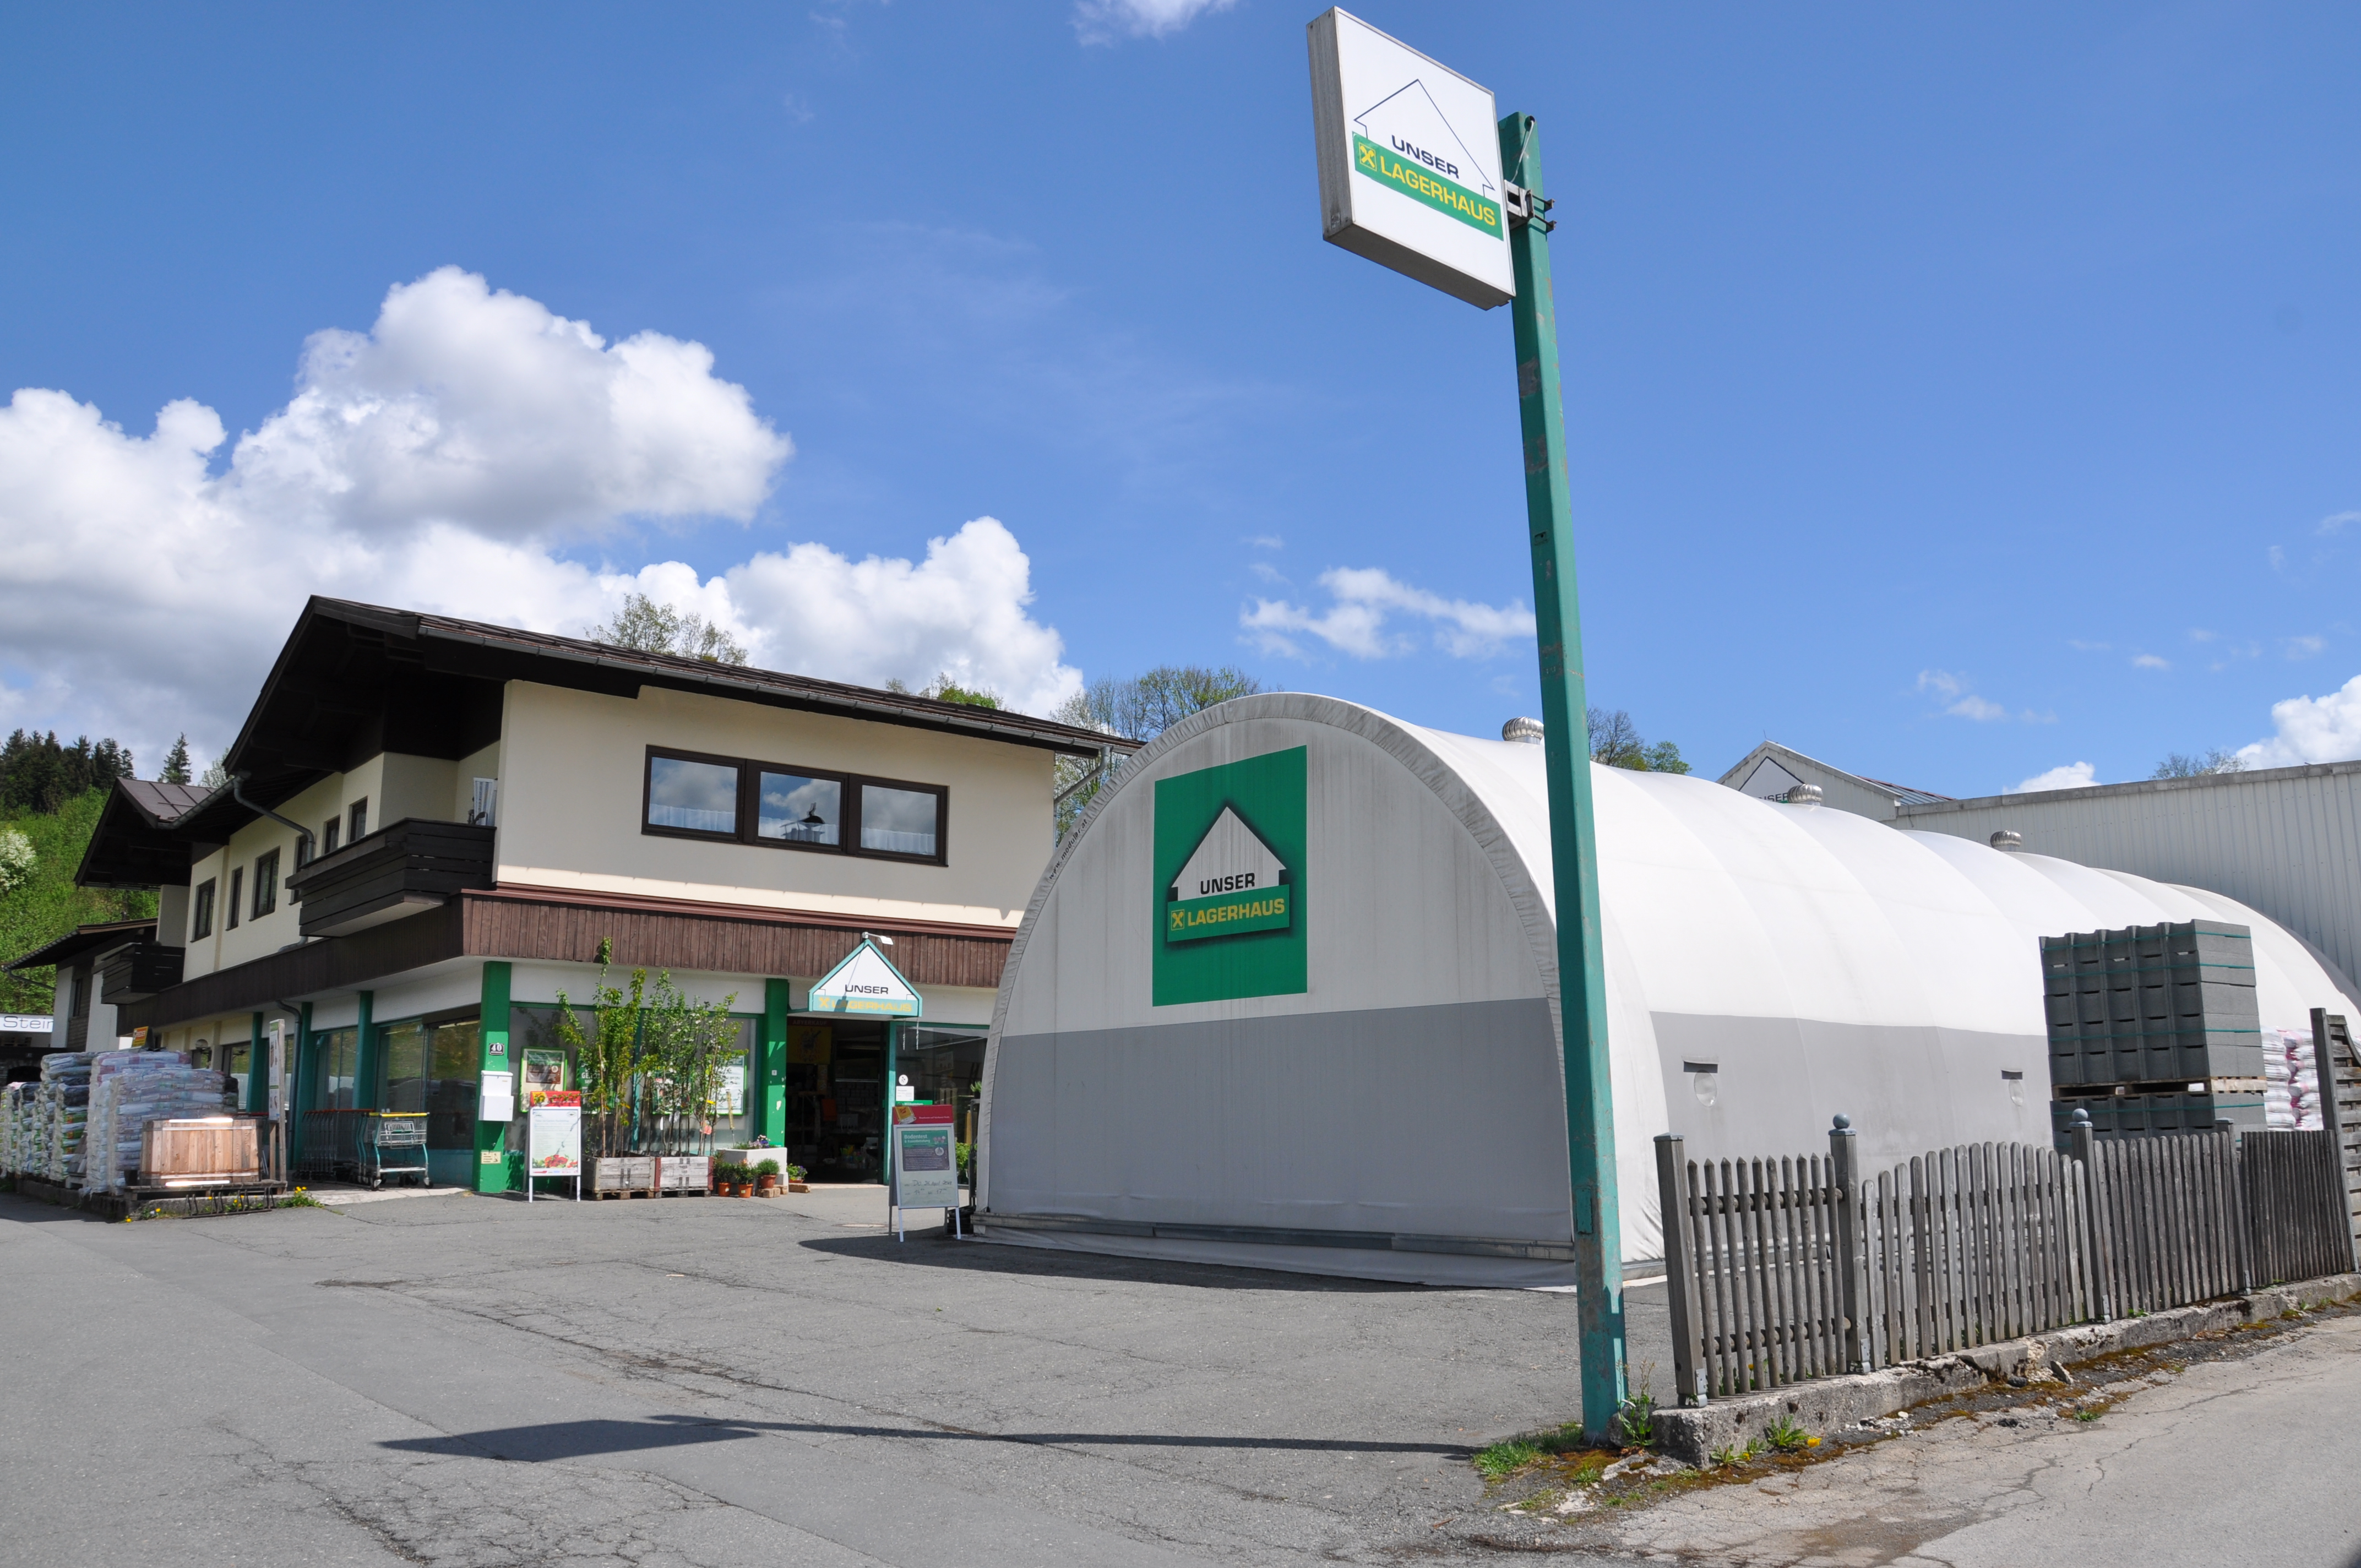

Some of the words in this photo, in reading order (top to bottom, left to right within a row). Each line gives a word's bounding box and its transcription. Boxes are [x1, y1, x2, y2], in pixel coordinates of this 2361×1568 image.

[1391, 134, 1459, 179] UNSER
[1380, 155, 1496, 226] LAGERHAUS
[1758, 792, 1788, 803] SER
[1200, 872, 1255, 895] UNSER
[1188, 898, 1285, 927] LAGERHAUS
[845, 984, 889, 995] UNSER
[831, 999, 912, 1012] LAGERHAUS
[491, 1043, 502, 1052] 40
